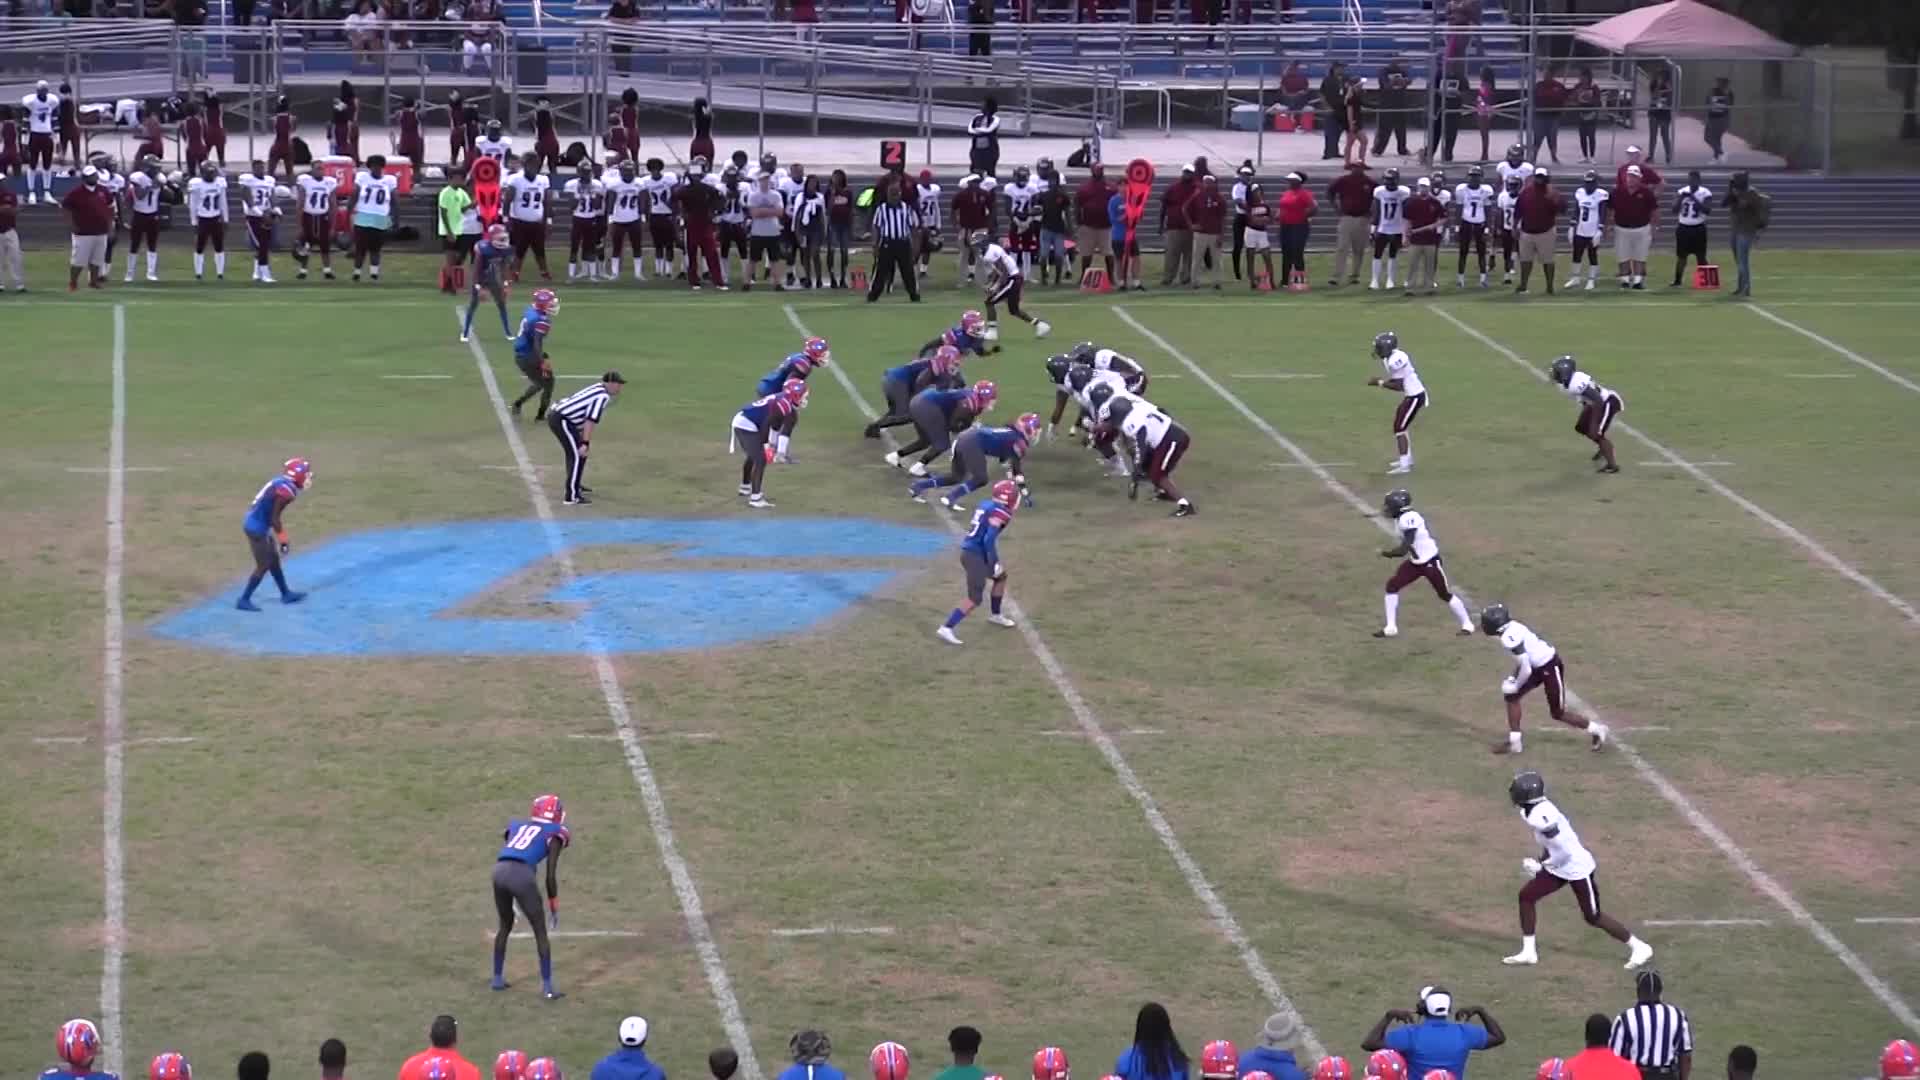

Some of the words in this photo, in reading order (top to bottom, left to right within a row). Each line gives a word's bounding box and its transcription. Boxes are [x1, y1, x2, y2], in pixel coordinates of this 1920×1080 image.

[885, 142, 902, 164] 2
[1082, 270, 1104, 289] 40
[1699, 267, 1719, 287] 30
[507, 824, 543, 850] 18
